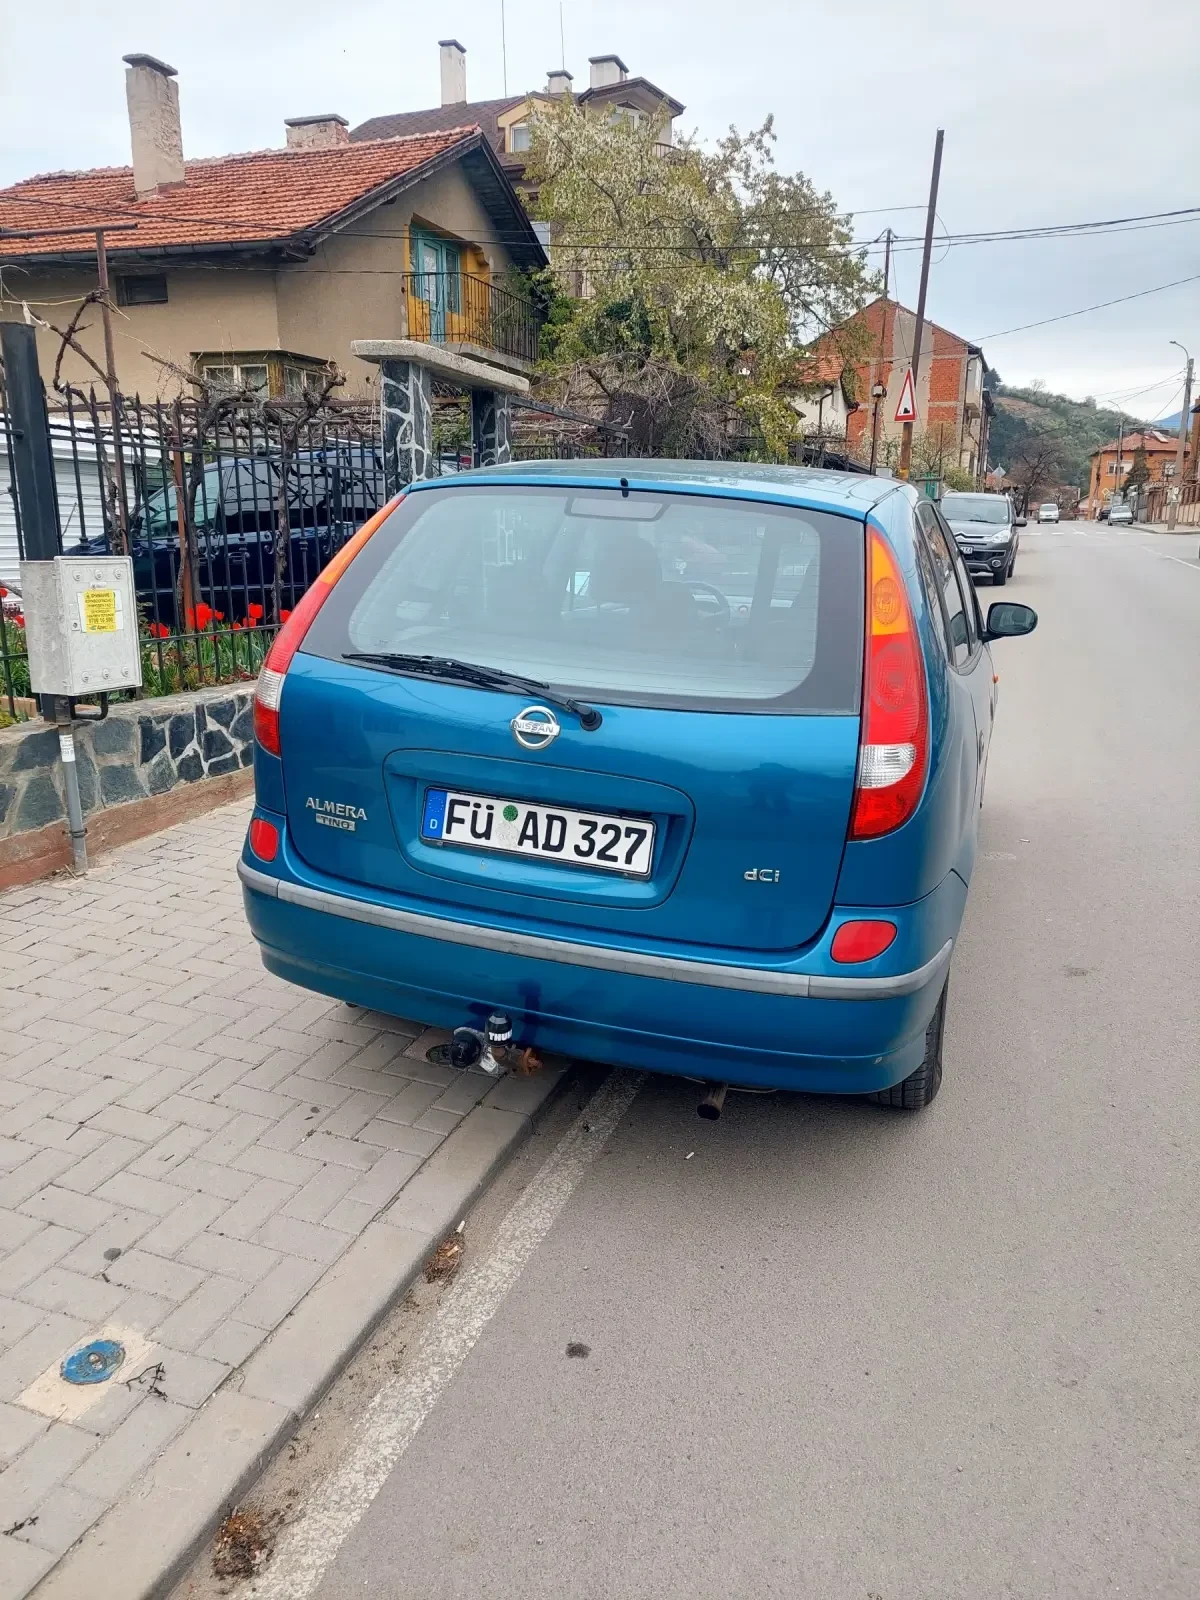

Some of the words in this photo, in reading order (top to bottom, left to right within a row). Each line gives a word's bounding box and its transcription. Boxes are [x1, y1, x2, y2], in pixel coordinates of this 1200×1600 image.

[511, 719, 554, 733] NISSAN
[305, 796, 368, 821] ALMERA
[320, 815, 351, 830] TINO
[429, 818, 438, 830] D
[445, 798, 494, 841] FÜ
[517, 810, 568, 853] AD
[573, 819, 648, 865] 327
[743, 867, 780, 883] dCi
